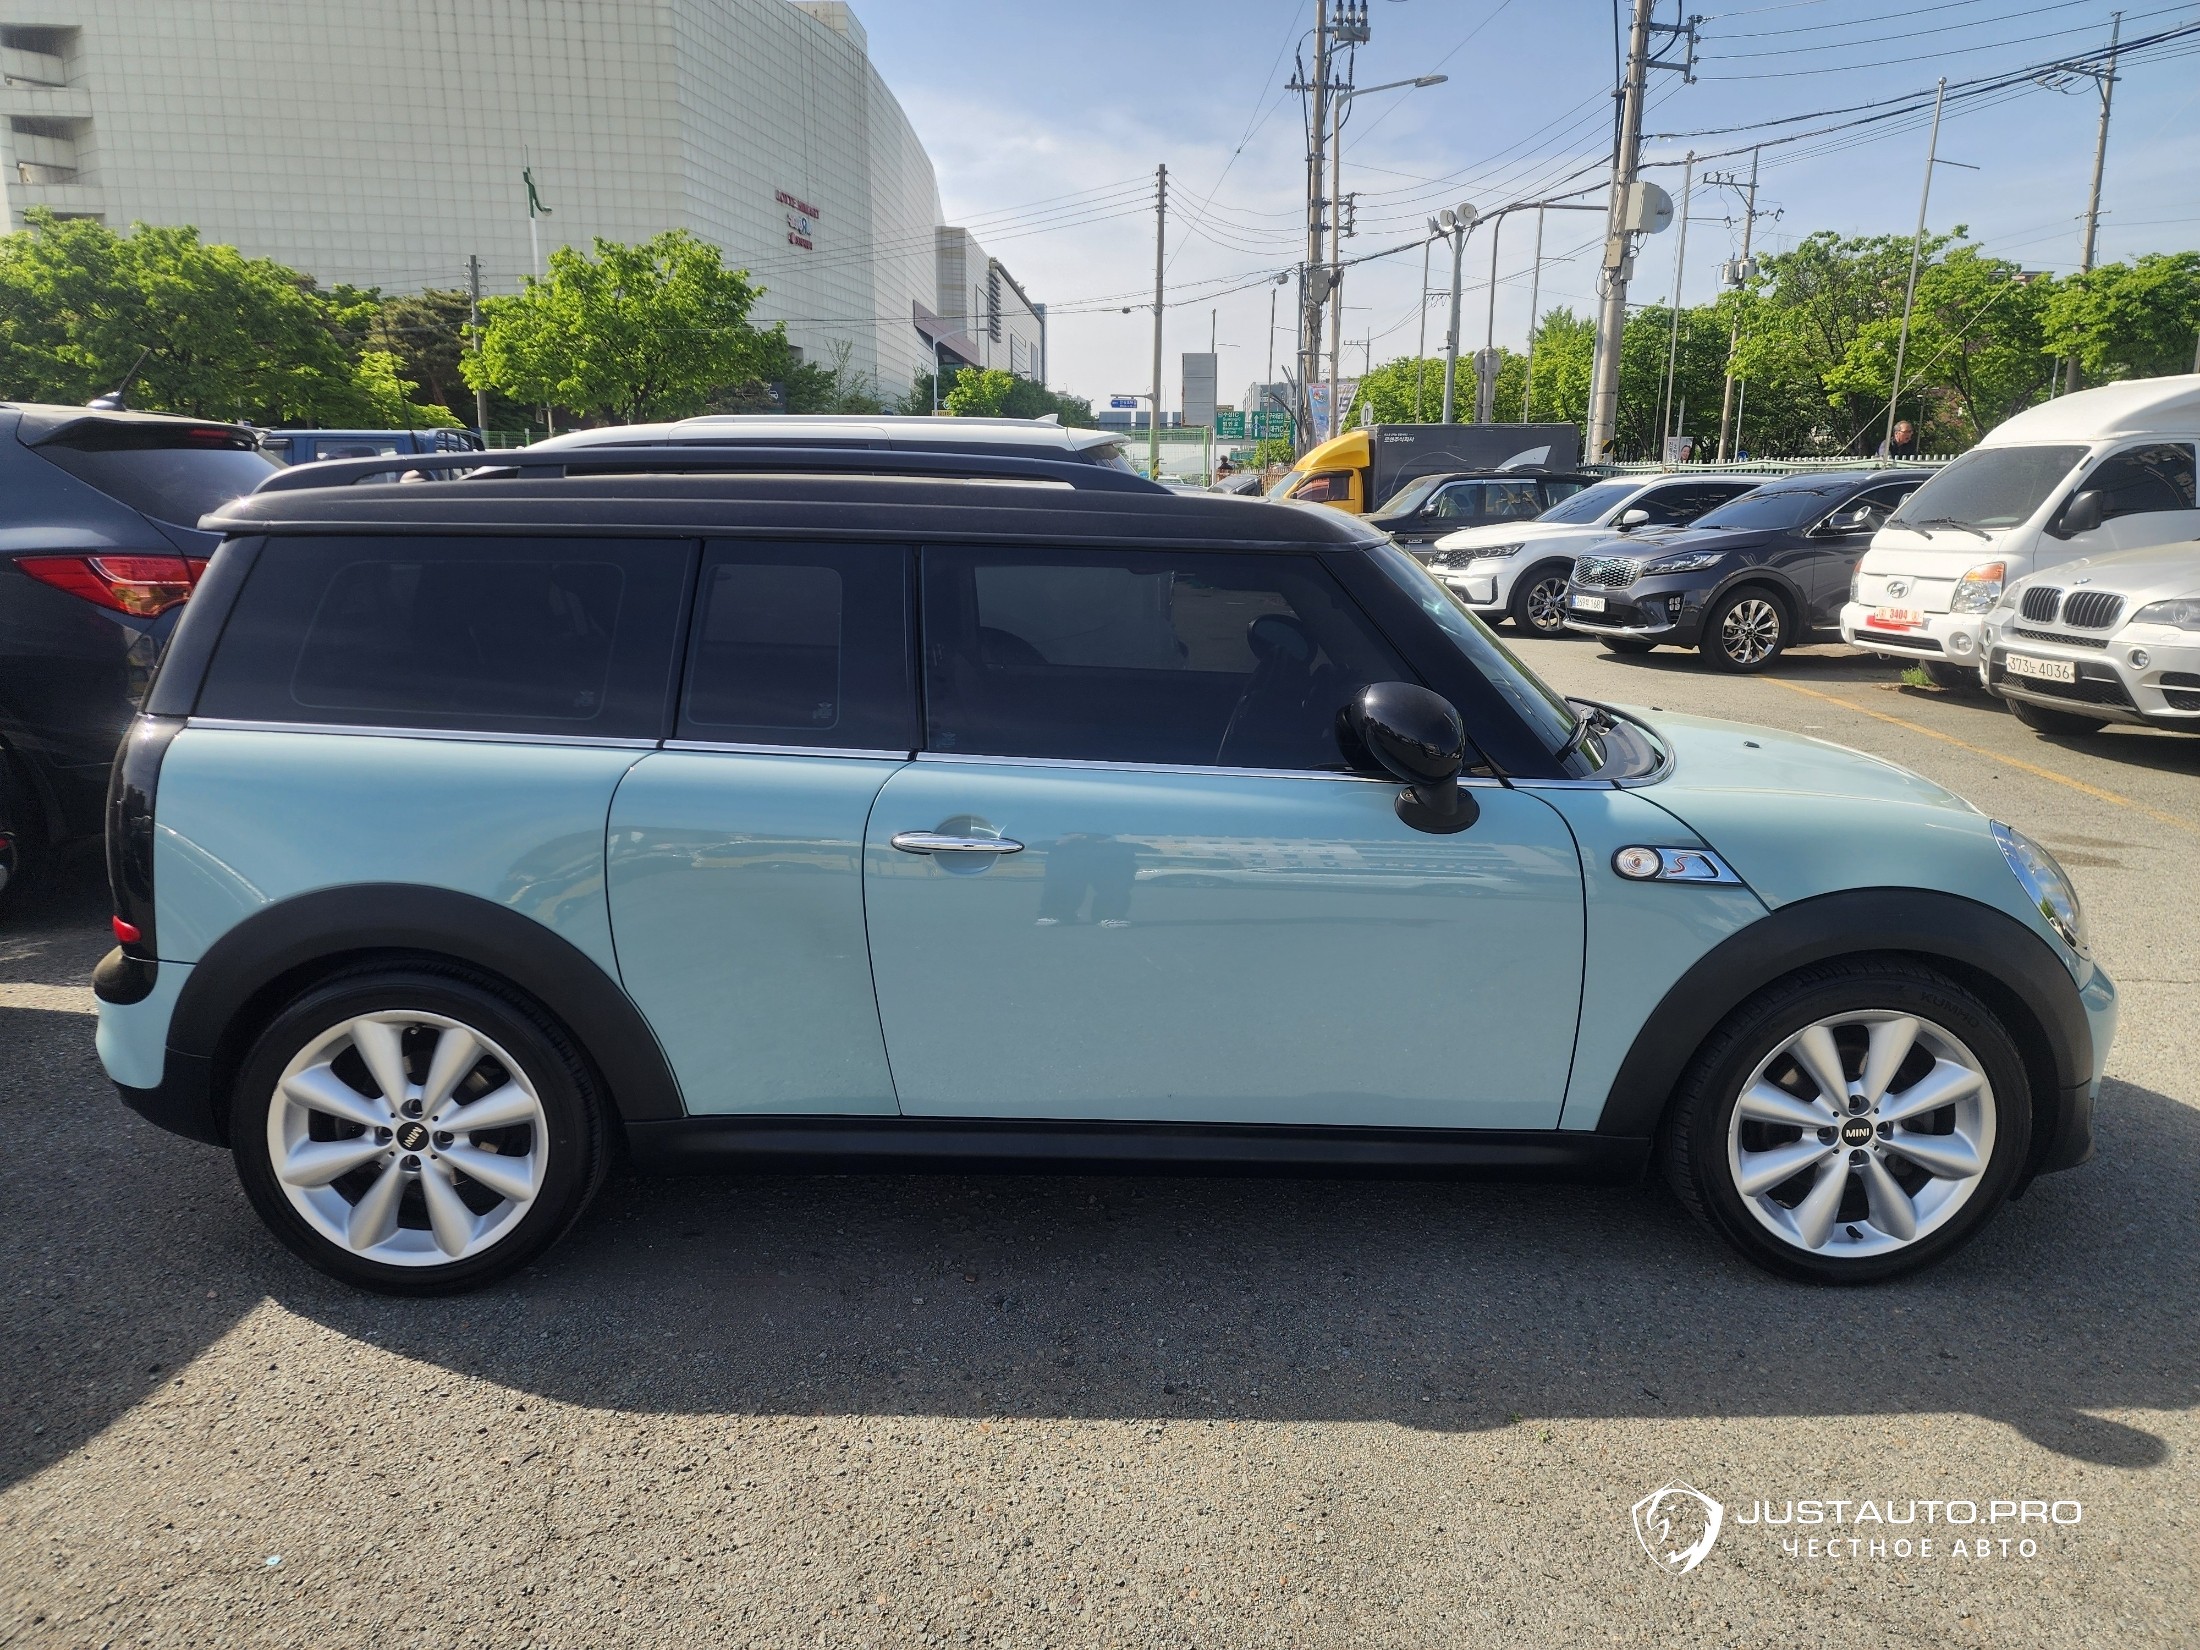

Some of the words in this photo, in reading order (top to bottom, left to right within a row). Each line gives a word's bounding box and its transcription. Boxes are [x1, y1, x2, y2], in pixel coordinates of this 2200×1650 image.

[1890, 609, 1908, 619] 3404
[2009, 657, 2036, 673] 373노
[2039, 663, 2070, 679] 4036
[403, 1126, 424, 1147] MINI
[1846, 1128, 1869, 1138] MINI
